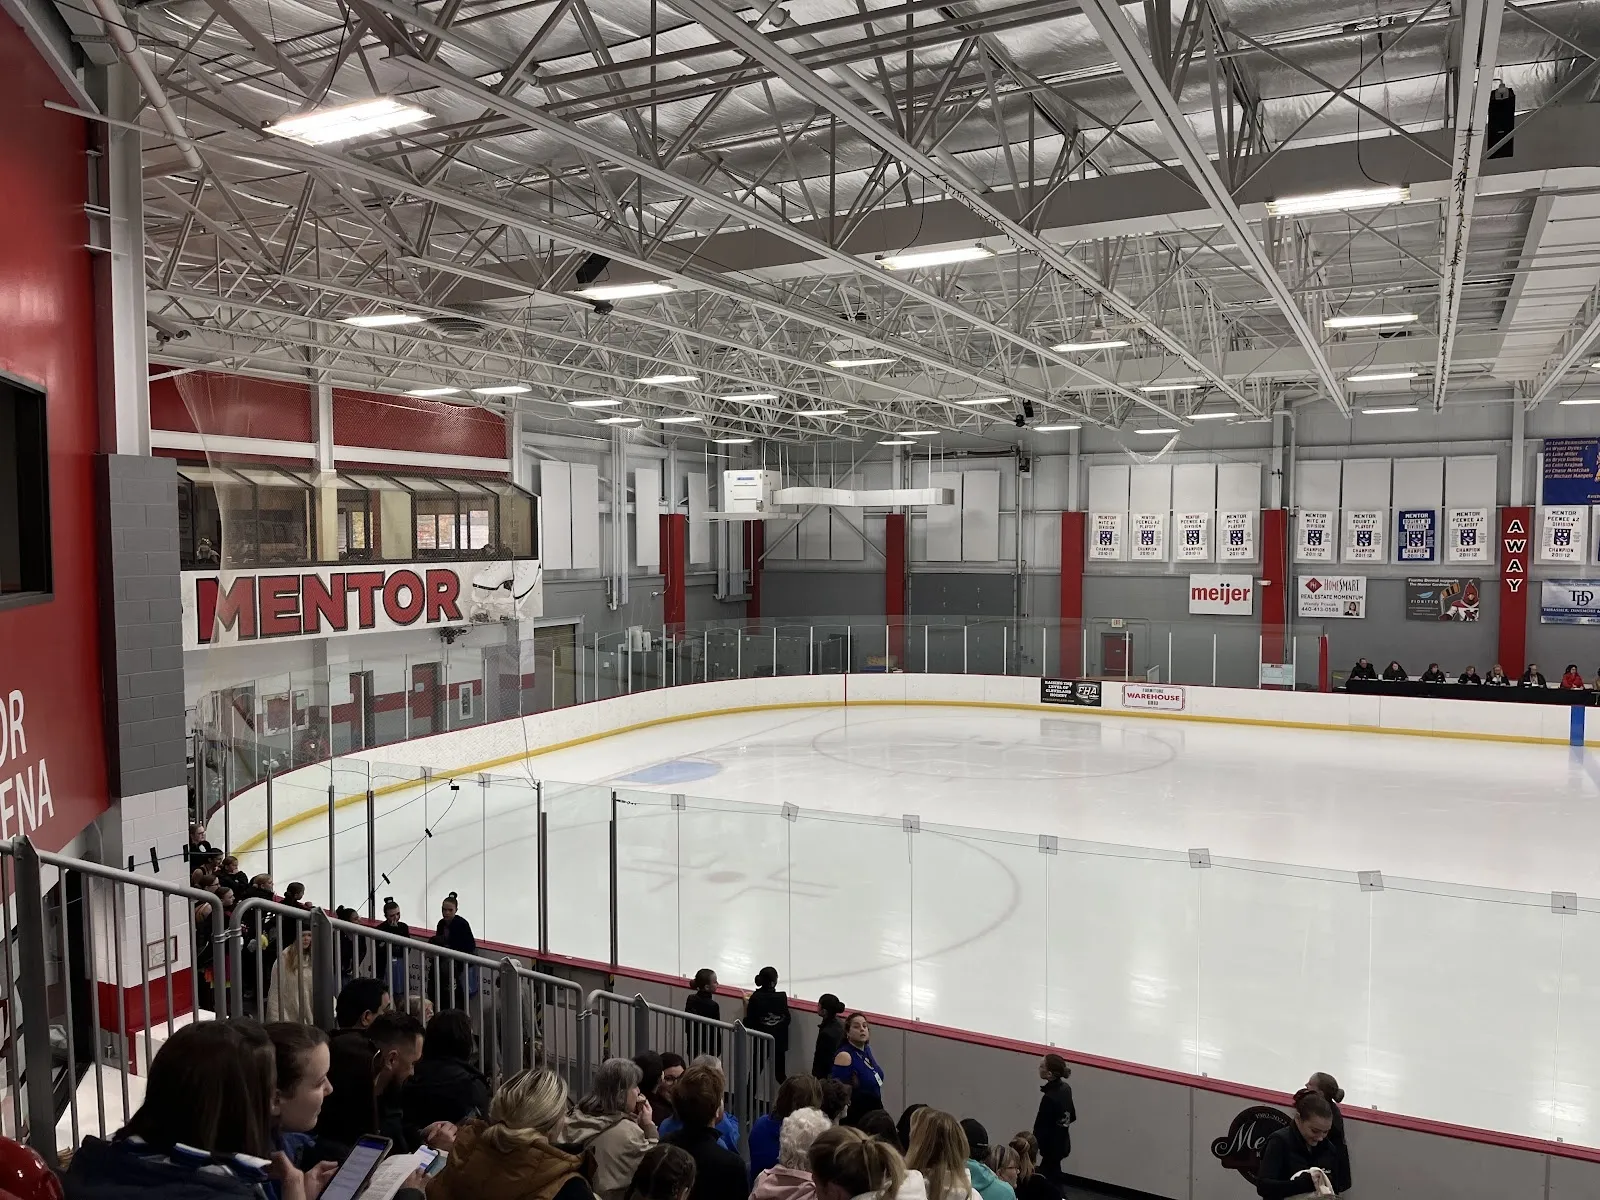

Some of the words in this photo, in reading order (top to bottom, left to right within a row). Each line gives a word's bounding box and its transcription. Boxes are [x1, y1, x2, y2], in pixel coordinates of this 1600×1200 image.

[1504, 520, 1527, 592] AWAY
[196, 569, 463, 644] MENTOR
[1192, 583, 1250, 605] meijer
[1215, 1121, 1265, 1156] Me
